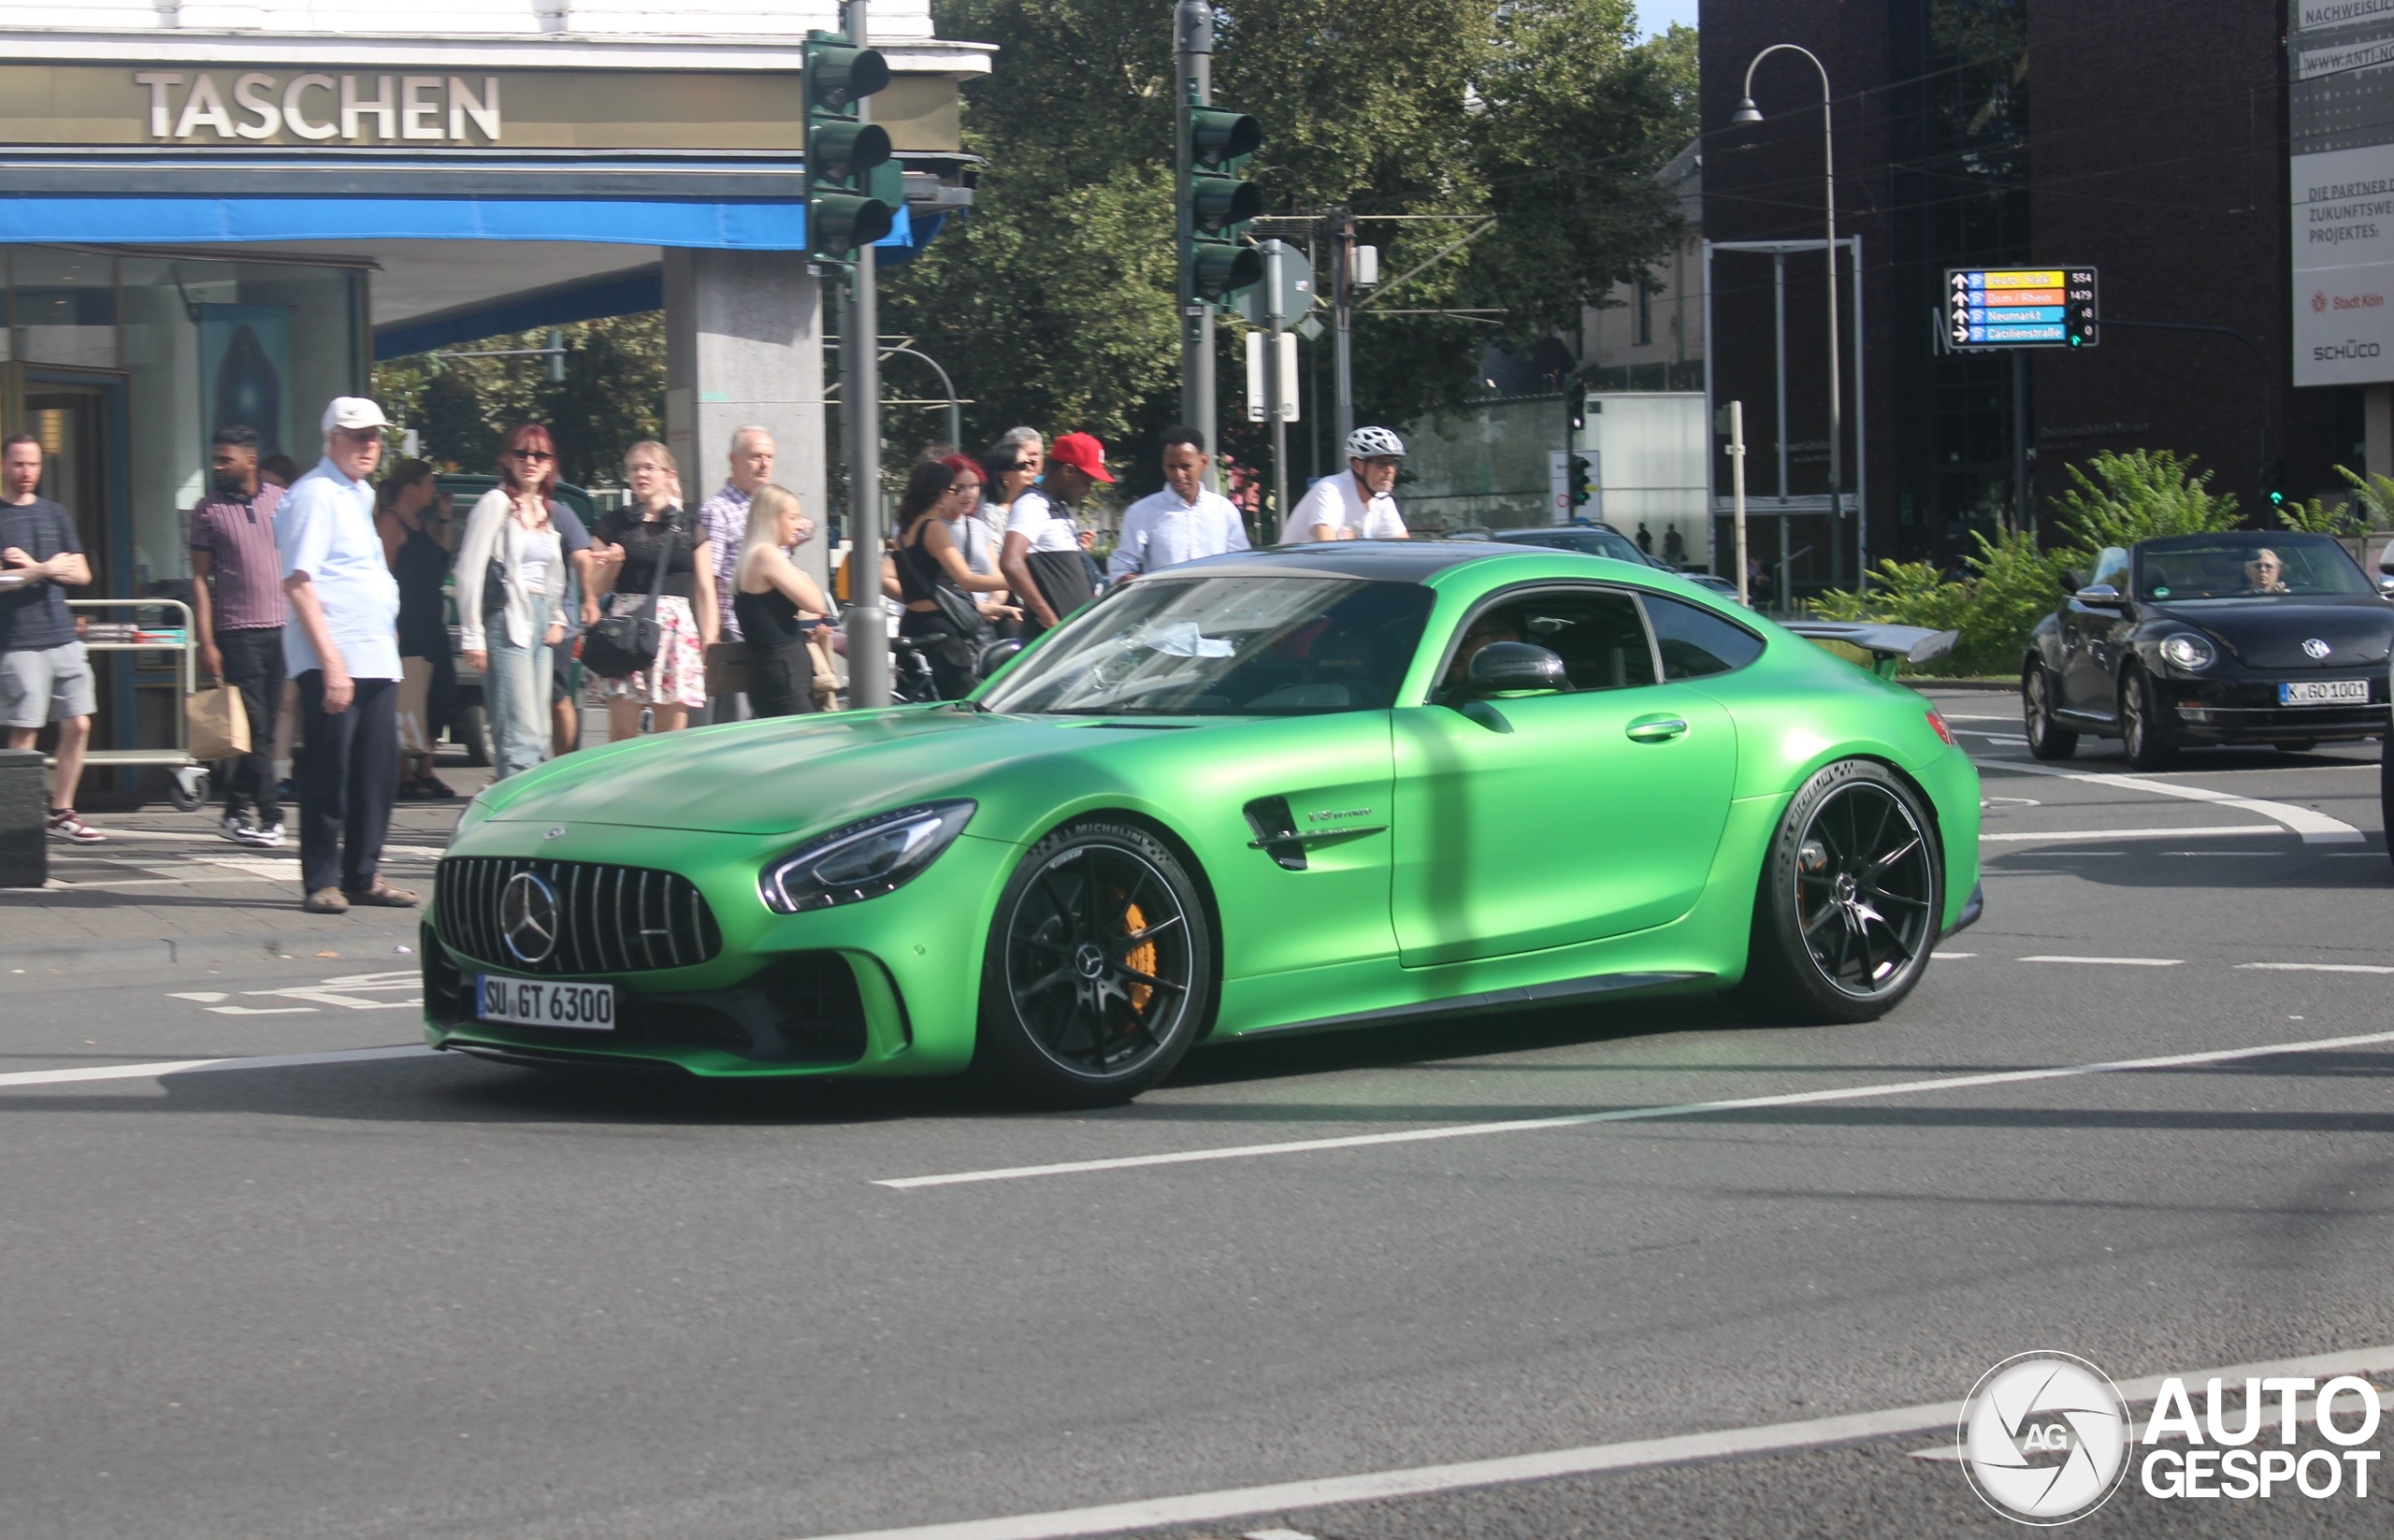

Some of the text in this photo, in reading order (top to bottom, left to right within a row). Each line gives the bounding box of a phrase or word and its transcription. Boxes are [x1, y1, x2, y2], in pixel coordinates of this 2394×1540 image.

[2306, 0, 2394, 23] NACHWEISLIC
[135, 72, 501, 139] TASCHEN
[2309, 186, 2329, 202] DIE
[2332, 180, 2387, 199] PARTNER
[2309, 200, 2394, 223] ZUKUNFTSWE
[2309, 223, 2380, 245] PROJEKTES:
[2072, 272, 2092, 283] 554
[1988, 293, 2012, 304] Dom
[1987, 310, 2041, 322] Neumarkt
[2314, 339, 2380, 361] SCHÜCO
[2330, 683, 2366, 698] 1001
[1075, 823, 1143, 843] MICHELIN
[485, 981, 611, 1024] SU GT 6300
